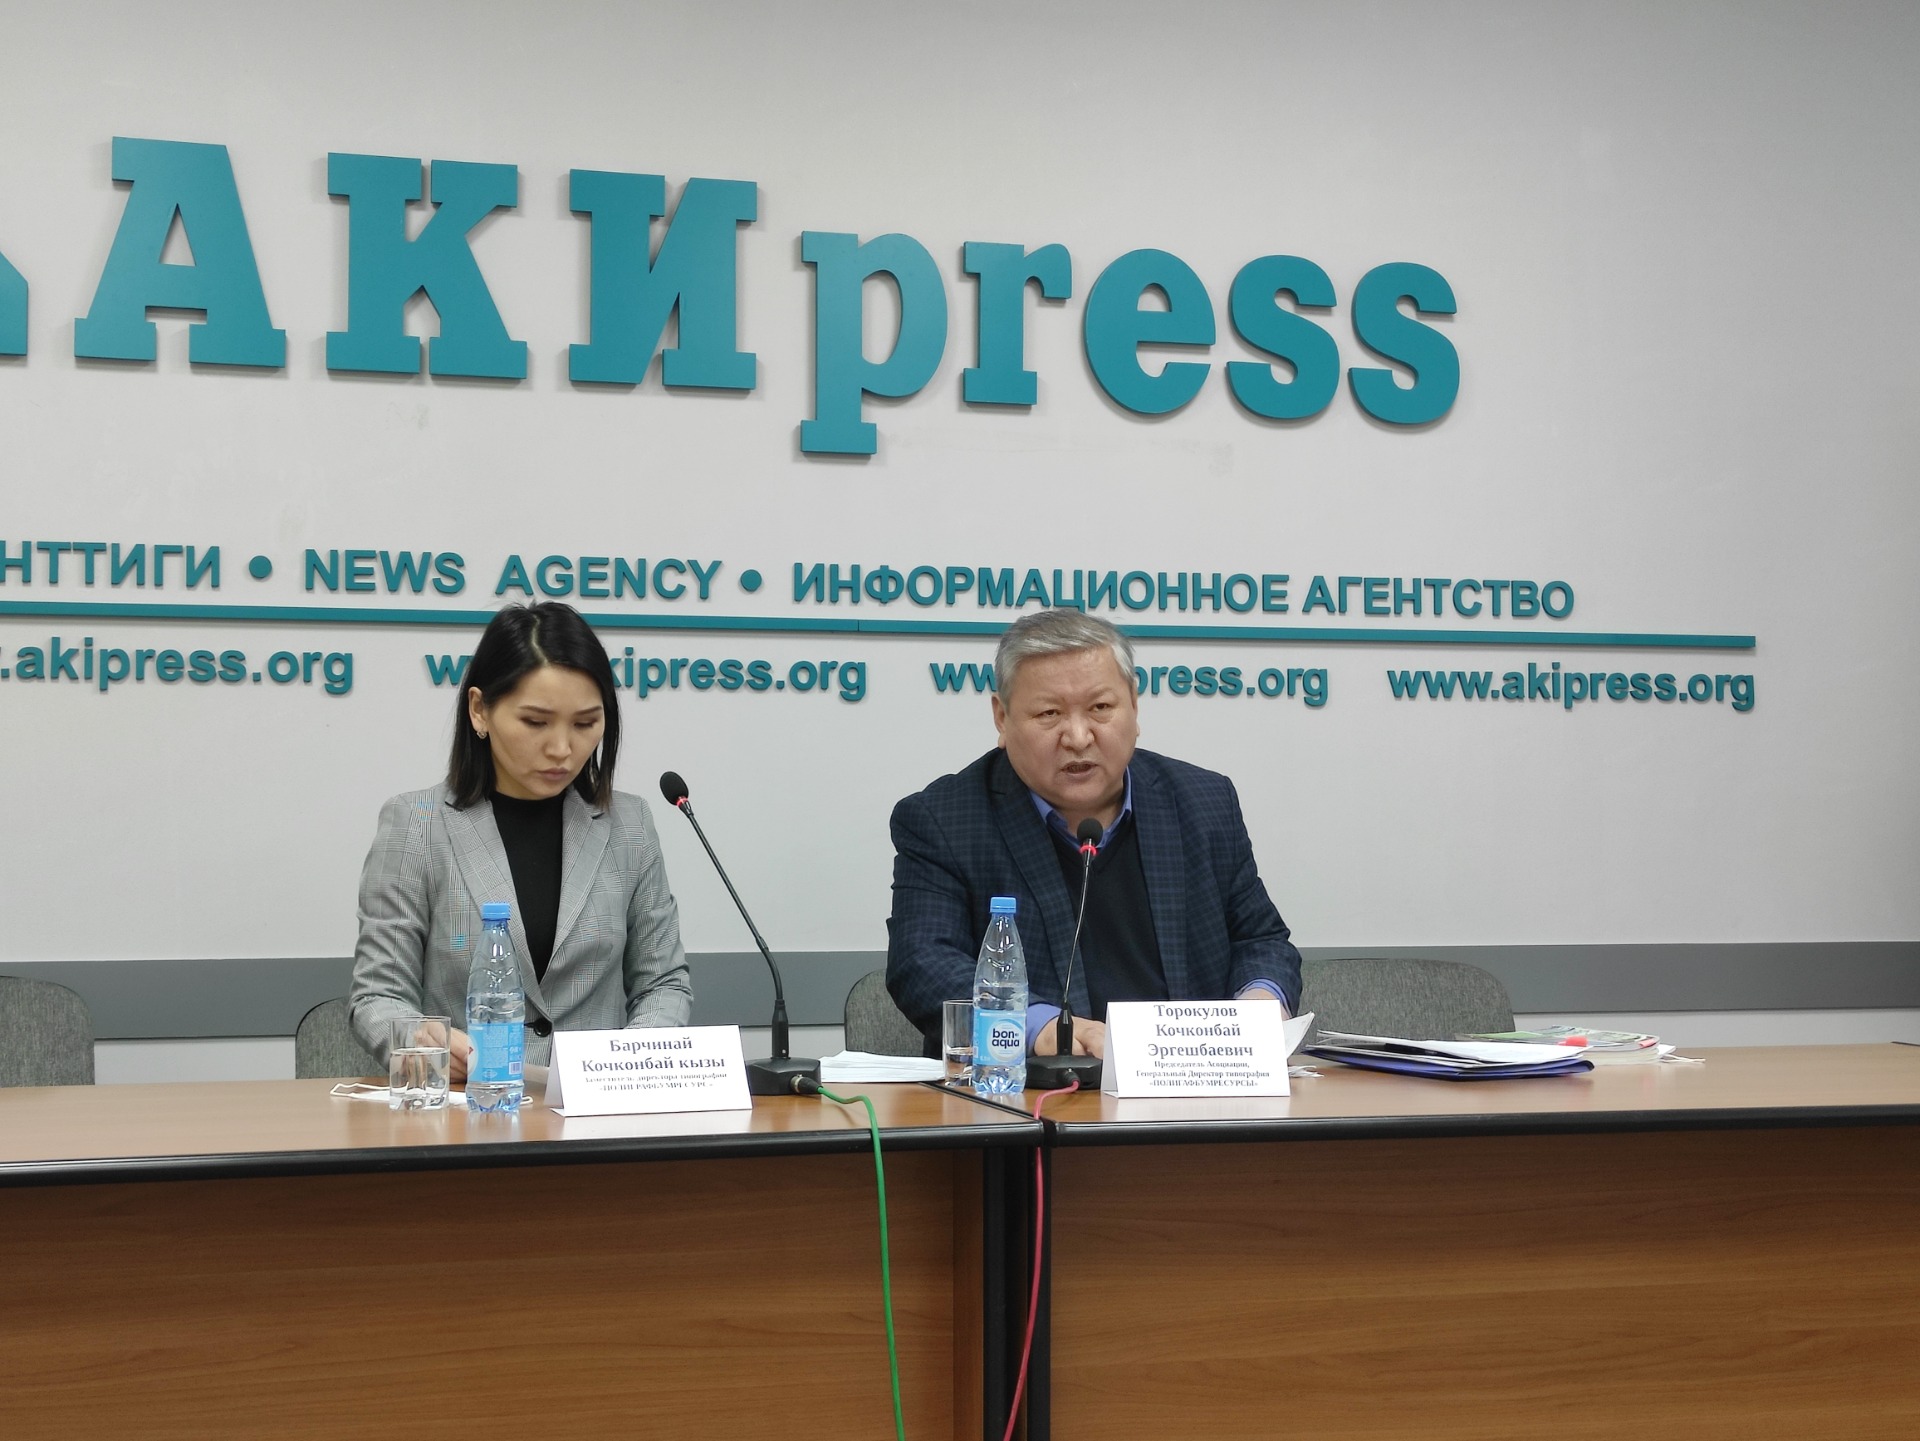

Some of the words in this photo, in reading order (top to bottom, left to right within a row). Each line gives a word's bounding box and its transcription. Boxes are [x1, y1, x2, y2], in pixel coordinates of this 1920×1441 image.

[304, 549, 466, 594] NEWS
[495, 554, 722, 600] AGENCY
[793, 562, 1290, 613] ИНФОРМАЦИОННОЕ
[1302, 575, 1575, 618] АГЕНТСТВО
[0, 636, 353, 695] .akipress.org
[1388, 662, 1755, 712] www.akipress.org
[1154, 1004, 1238, 1020] Торокулов
[1155, 1023, 1241, 1037] Кочконбай
[609, 1036, 693, 1054] Барчинай
[992, 1039, 1020, 1049] aqua
[1147, 1043, 1254, 1060] Эргешбаевич
[582, 1056, 675, 1073] Кочконбай
[679, 1057, 726, 1069] кызы
[1154, 1060, 1205, 1069] Председатель
[1136, 1069, 1186, 1079] Генеральный
[1188, 1070, 1224, 1079] Директор
